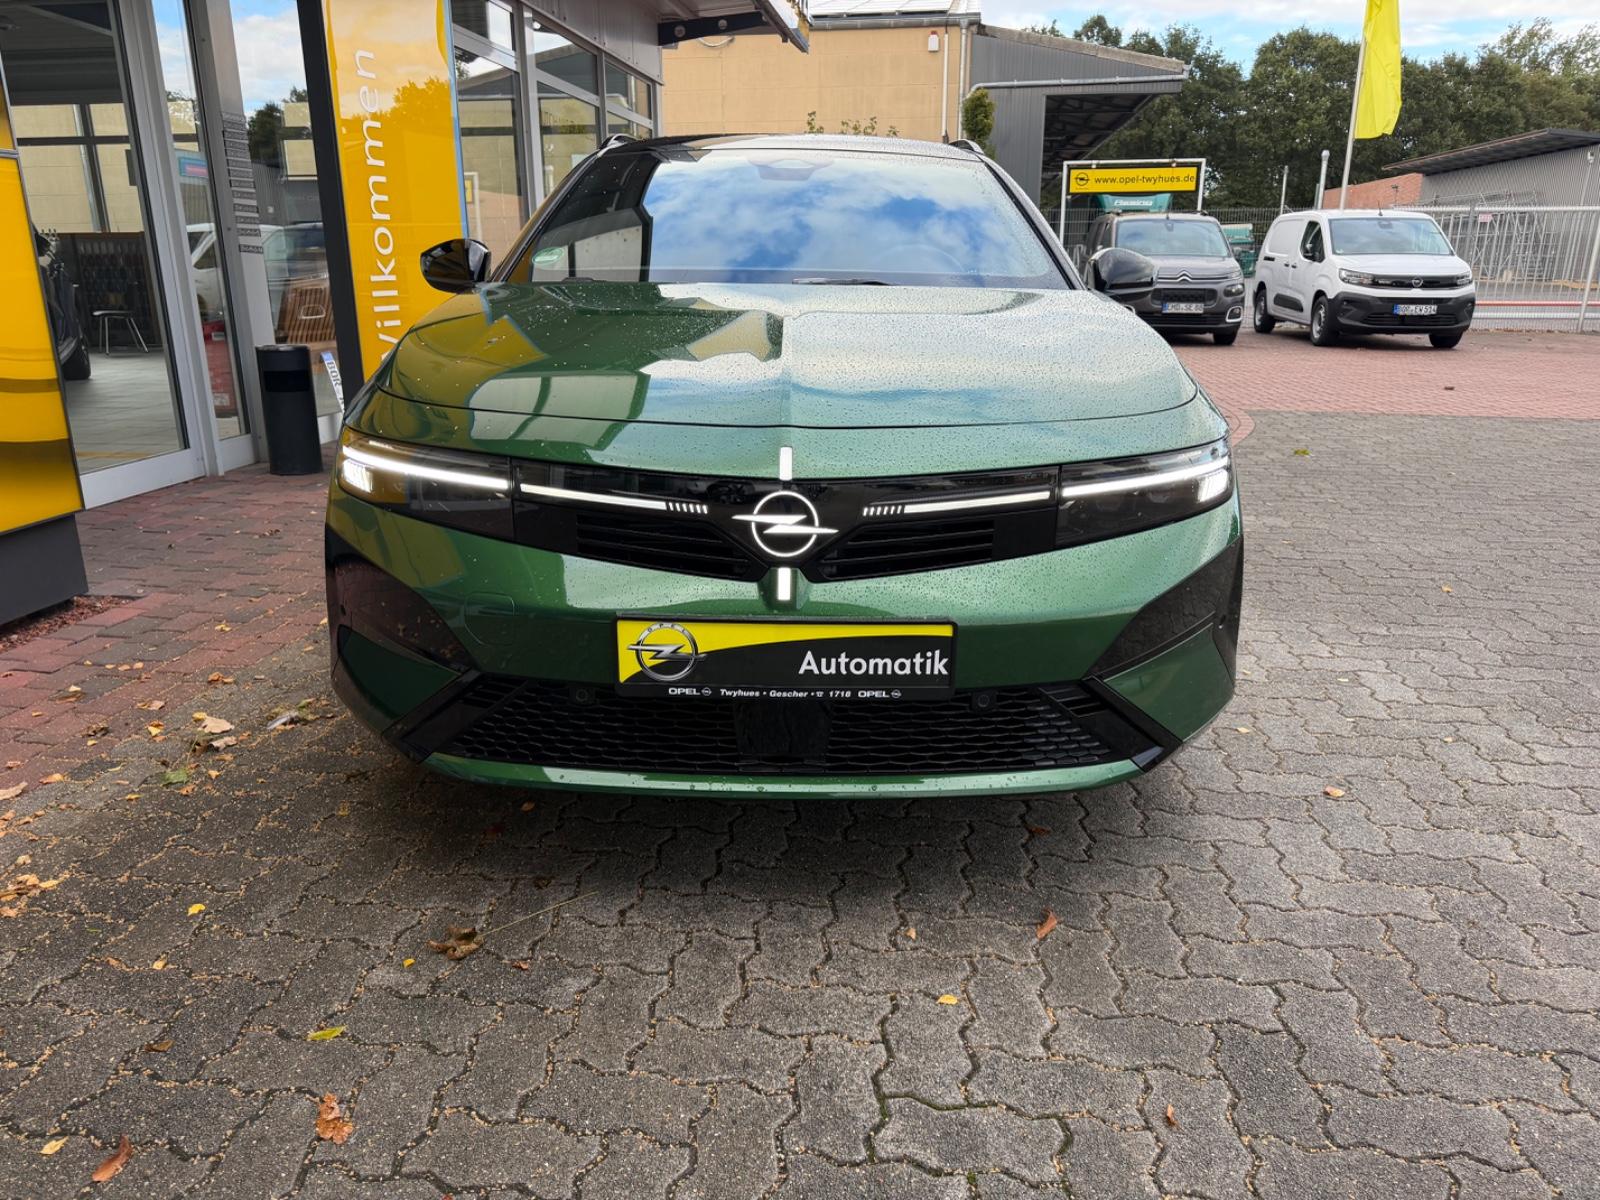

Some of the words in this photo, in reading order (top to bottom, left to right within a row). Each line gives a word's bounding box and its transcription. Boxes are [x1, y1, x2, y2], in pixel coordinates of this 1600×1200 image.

[1094, 173, 1195, 185] www.opel-twyhues.de
[799, 650, 949, 675] Automatik
[668, 687, 700, 695] OPEL
[720, 688, 760, 698] Twyhues
[769, 689, 809, 698] Gescher
[858, 690, 890, 698] OPEL
